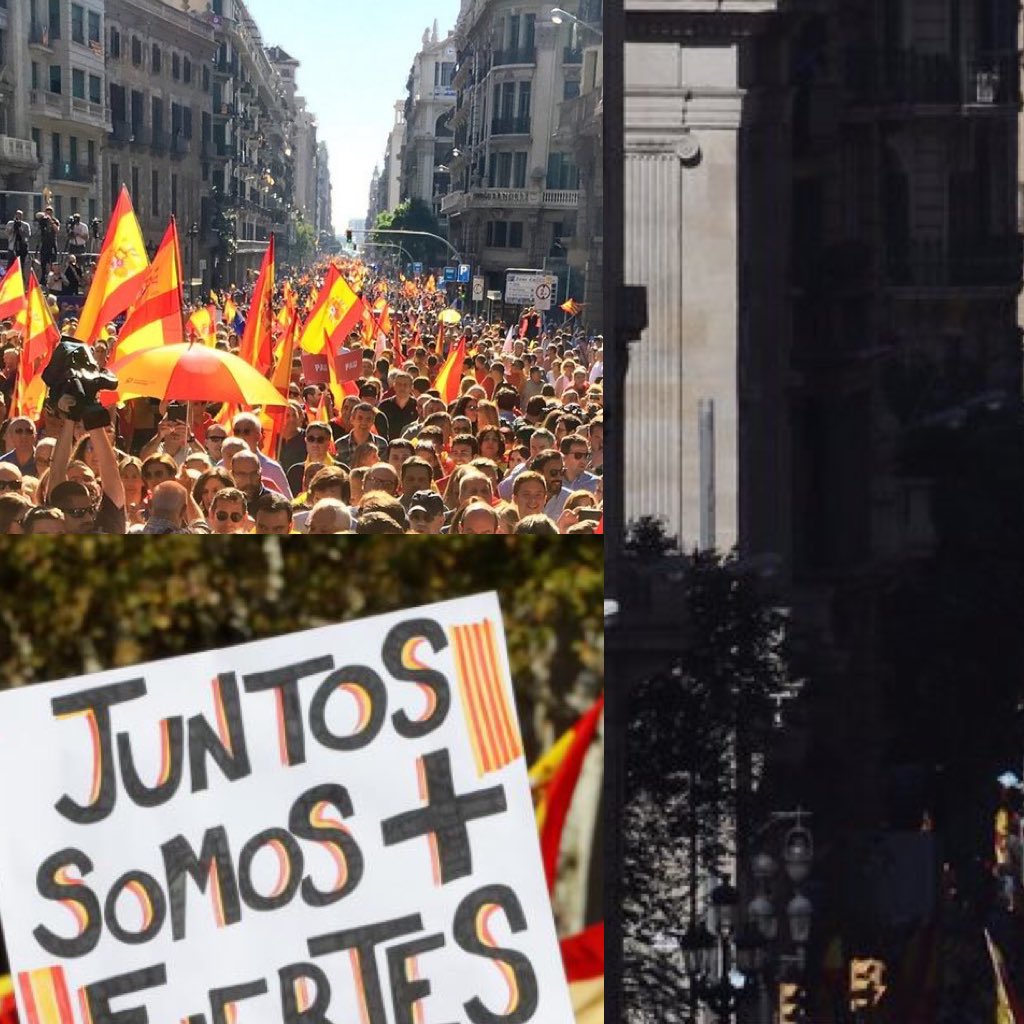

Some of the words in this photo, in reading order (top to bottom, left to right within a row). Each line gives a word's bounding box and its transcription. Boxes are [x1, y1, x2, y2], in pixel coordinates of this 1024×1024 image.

[51, 618, 451, 824] JUNTOS
[33, 783, 363, 958] SOMOS
[381, 748, 507, 887] +
